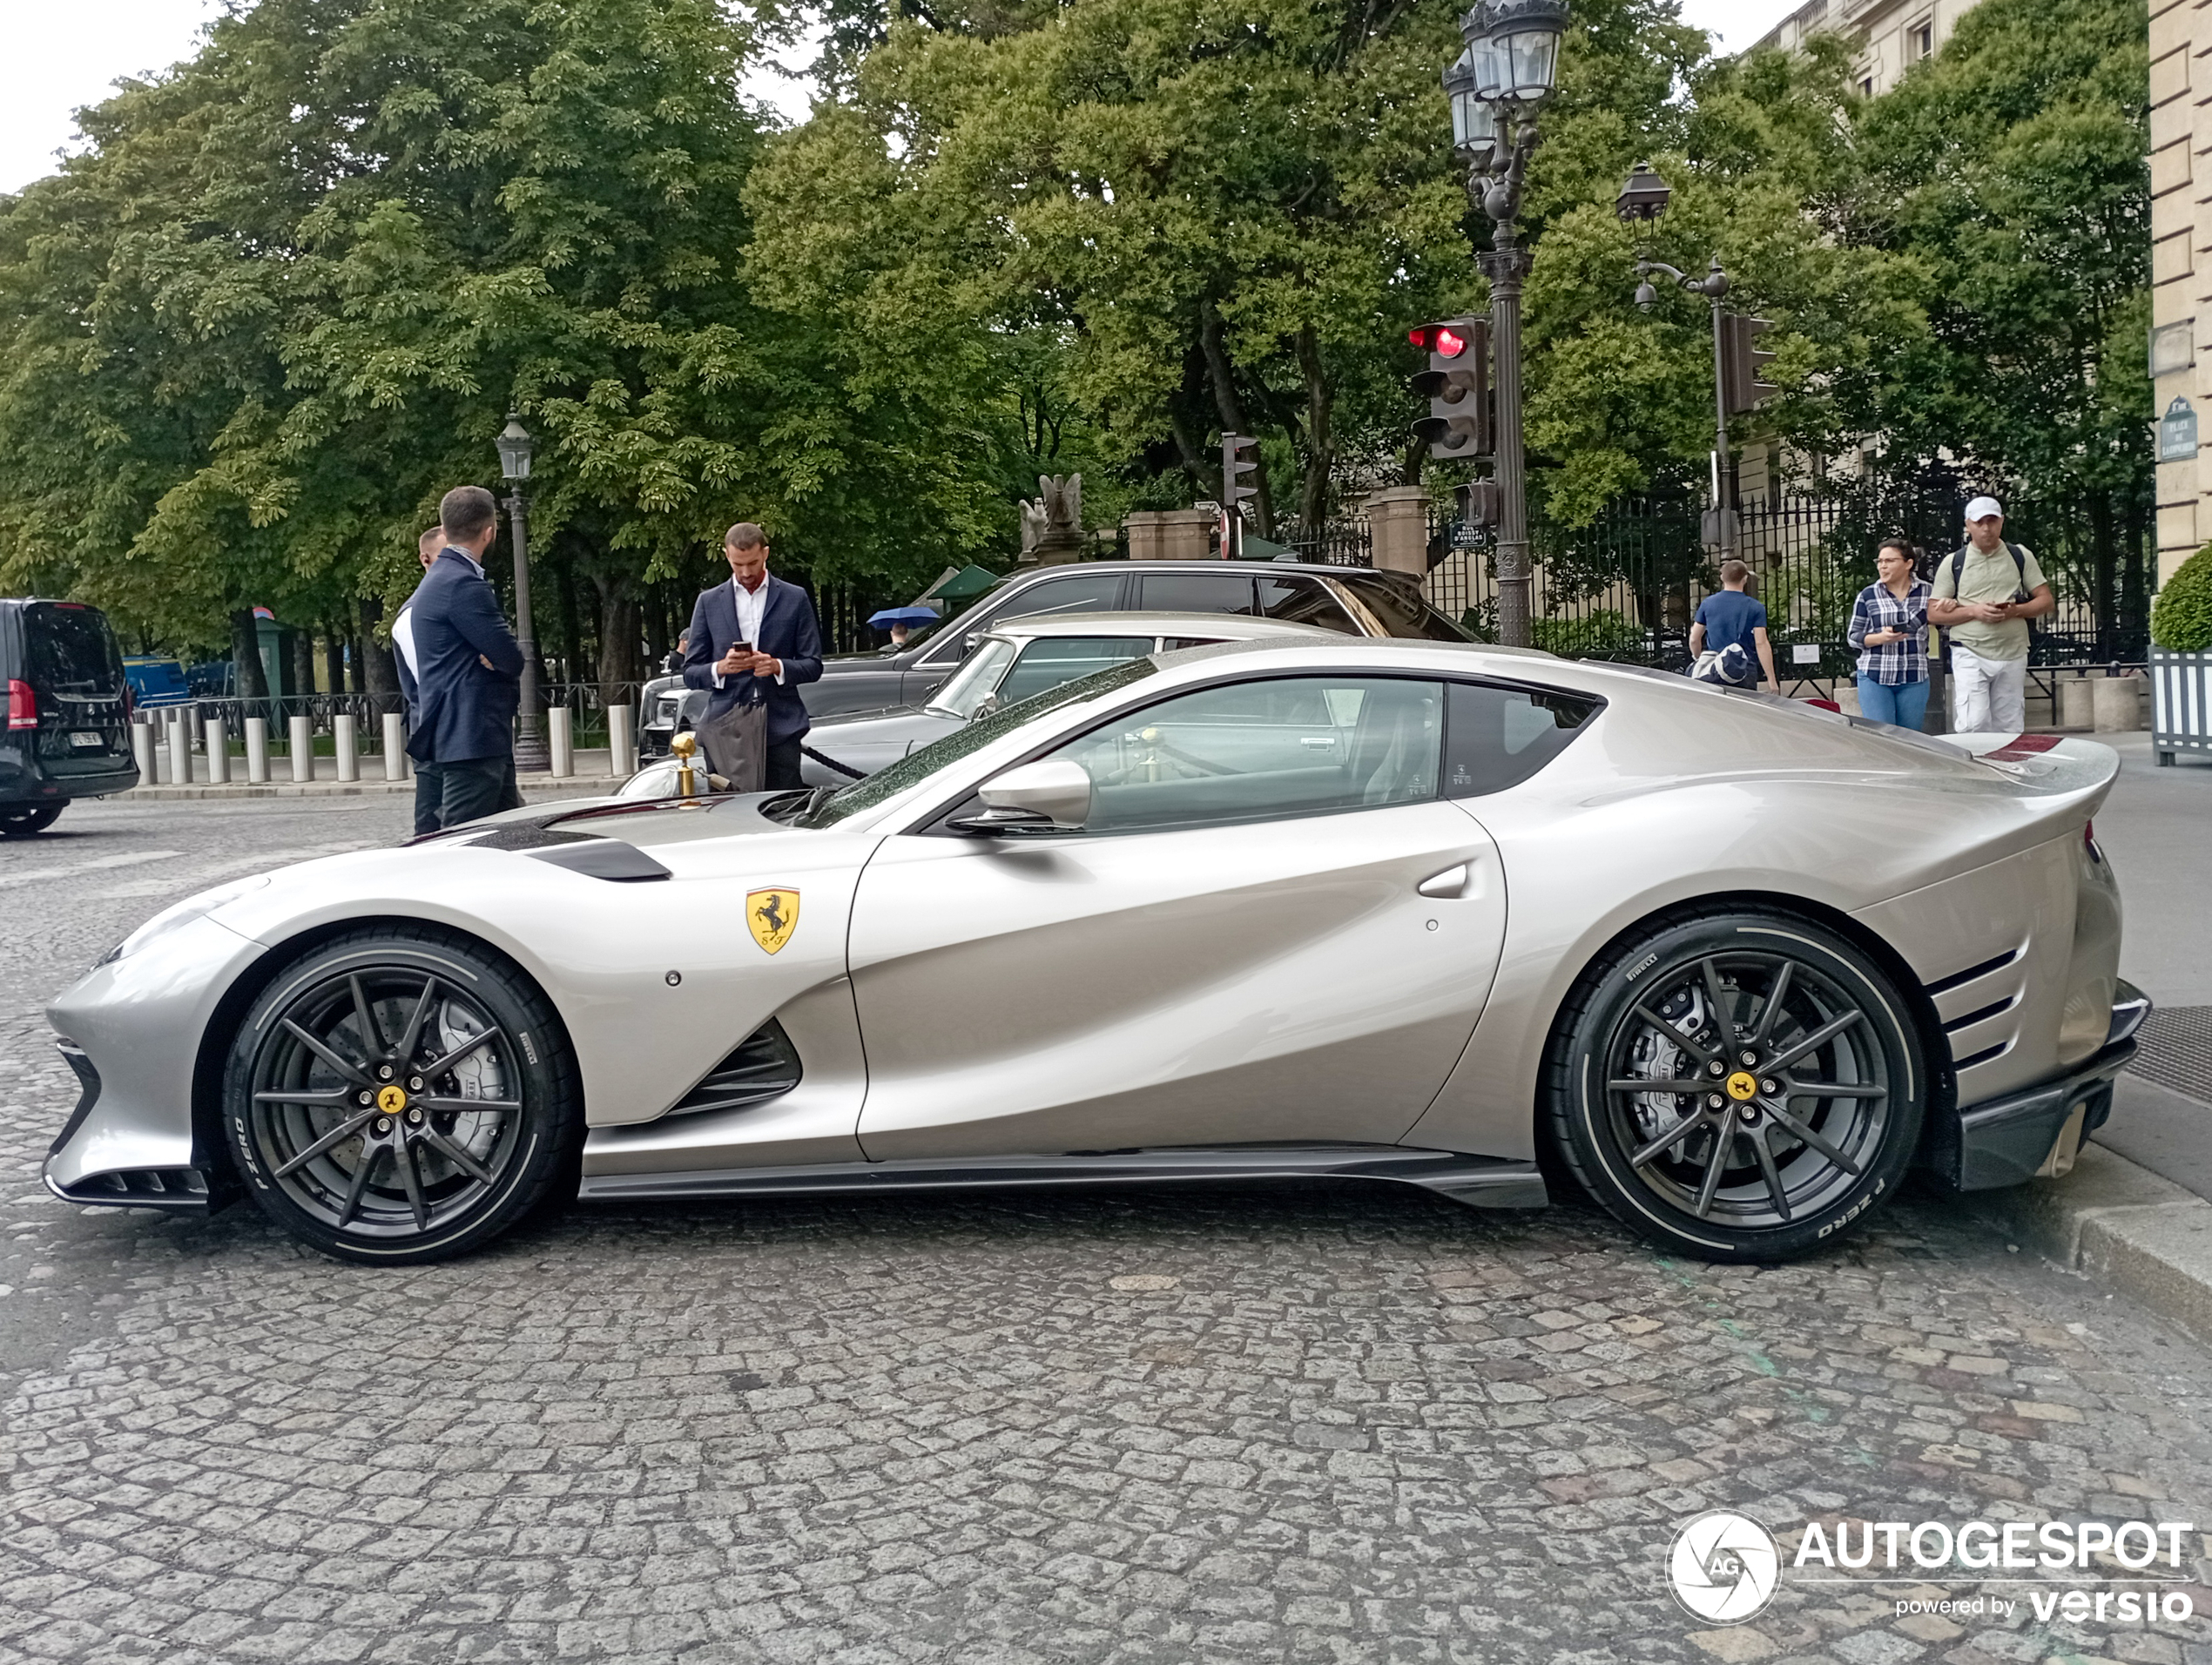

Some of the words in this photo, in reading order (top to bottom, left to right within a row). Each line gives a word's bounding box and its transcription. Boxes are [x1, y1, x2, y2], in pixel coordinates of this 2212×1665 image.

[1626, 953, 1658, 981] PIRELLI
[235, 1116, 260, 1175] ZERO
[255, 1177, 269, 1190] P
[1874, 1177, 1885, 1195] P
[1818, 1194, 1872, 1238] ZERO
